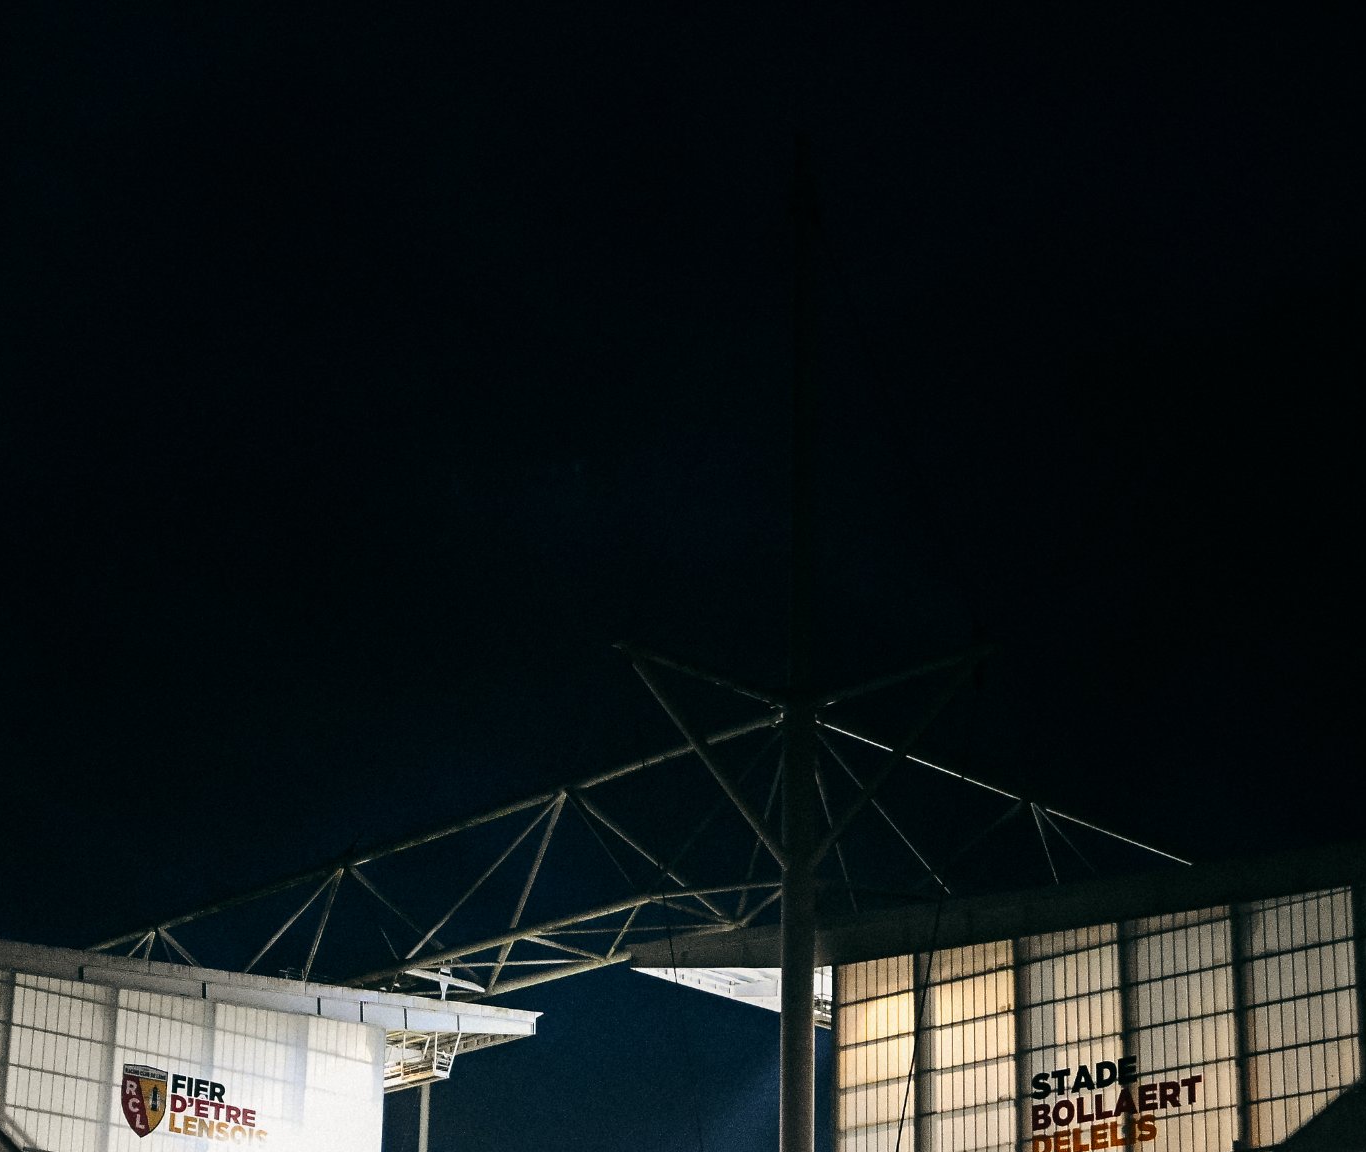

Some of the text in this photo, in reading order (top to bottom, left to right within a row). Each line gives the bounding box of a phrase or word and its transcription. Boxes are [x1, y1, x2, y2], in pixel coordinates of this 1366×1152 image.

[171, 1073, 226, 1104] FIER
[1031, 1056, 1137, 1100] STADE
[1031, 1075, 1202, 1131] BOLLAERT
[168, 1113, 268, 1146] LENSOIS
